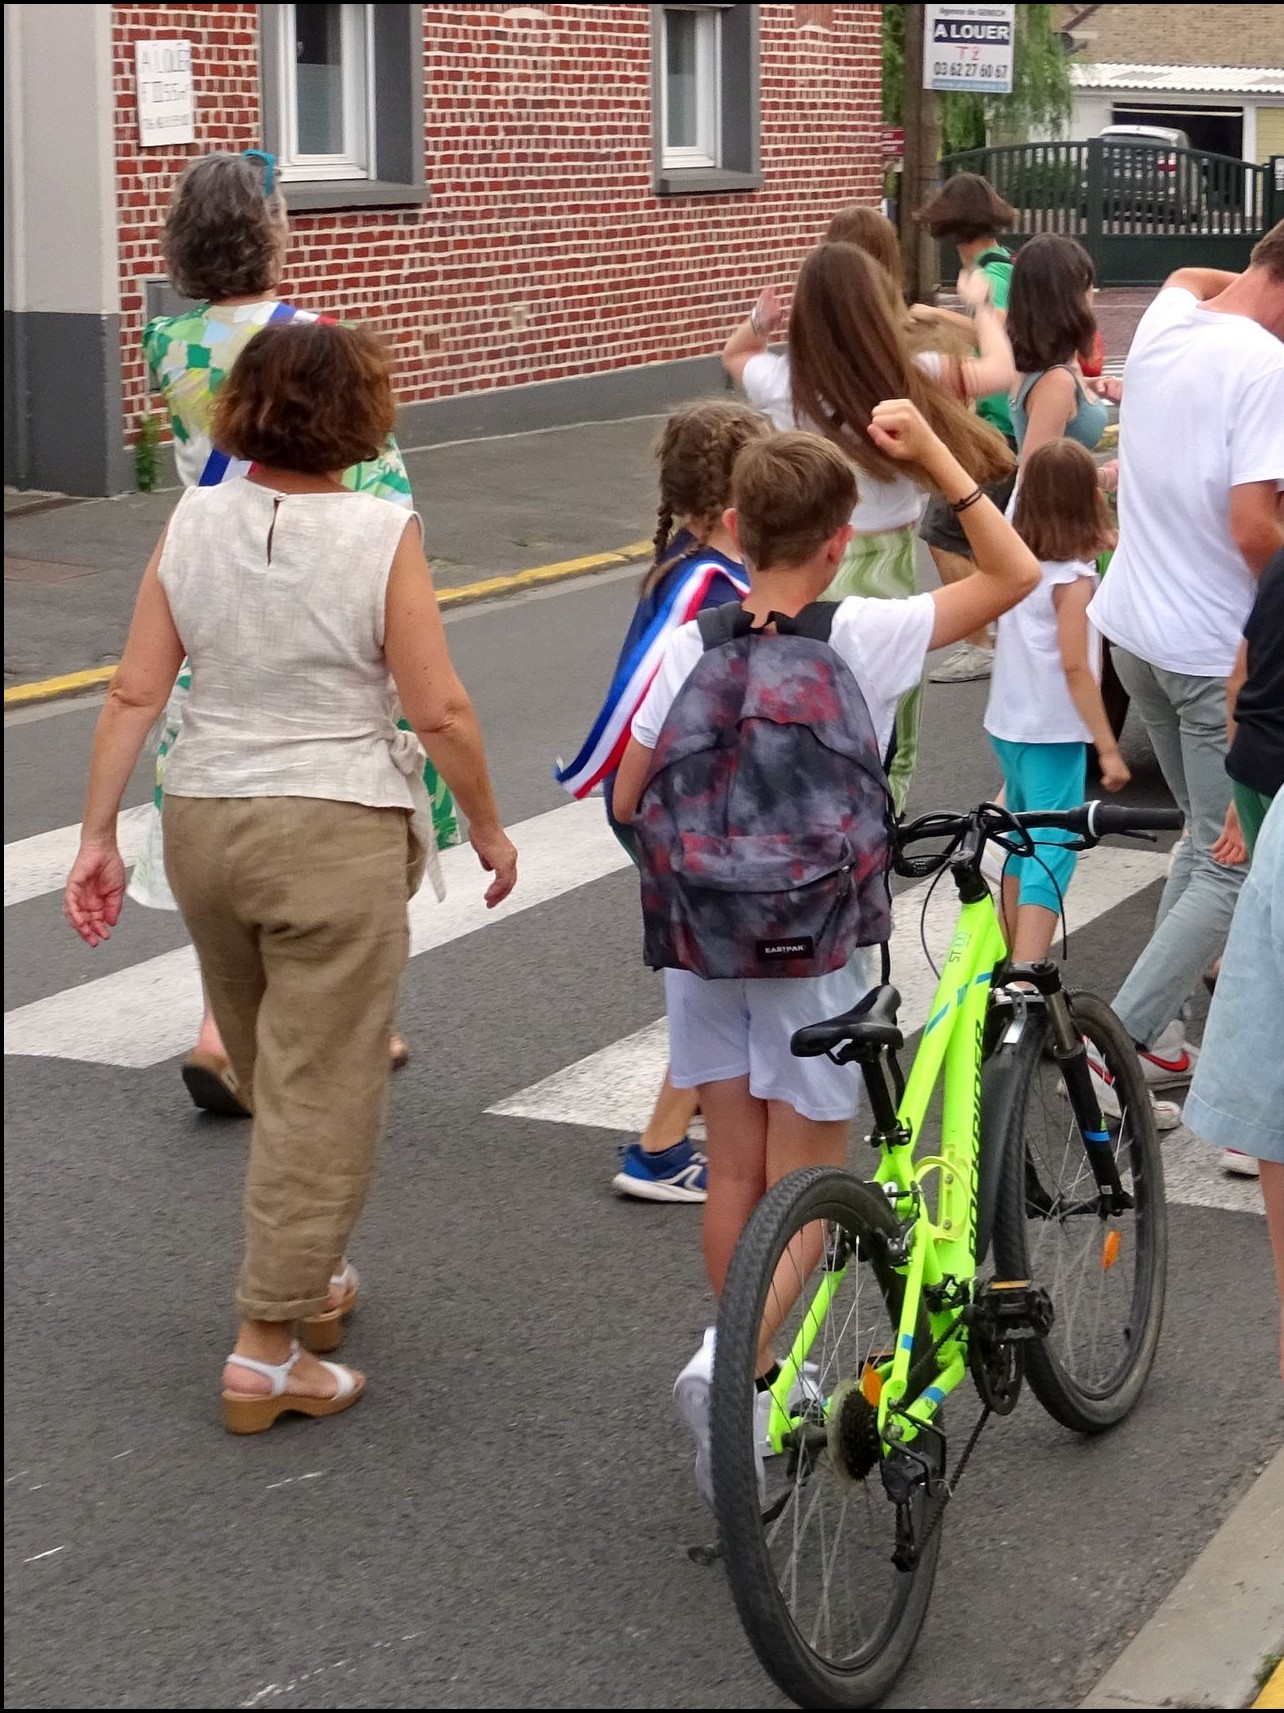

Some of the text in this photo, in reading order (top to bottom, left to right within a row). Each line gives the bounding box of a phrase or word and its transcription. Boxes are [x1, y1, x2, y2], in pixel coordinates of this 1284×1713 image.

[934, 24, 1009, 40] A LOUER
[965, 63, 978, 77] 27
[765, 945, 804, 953] EASTPAK
